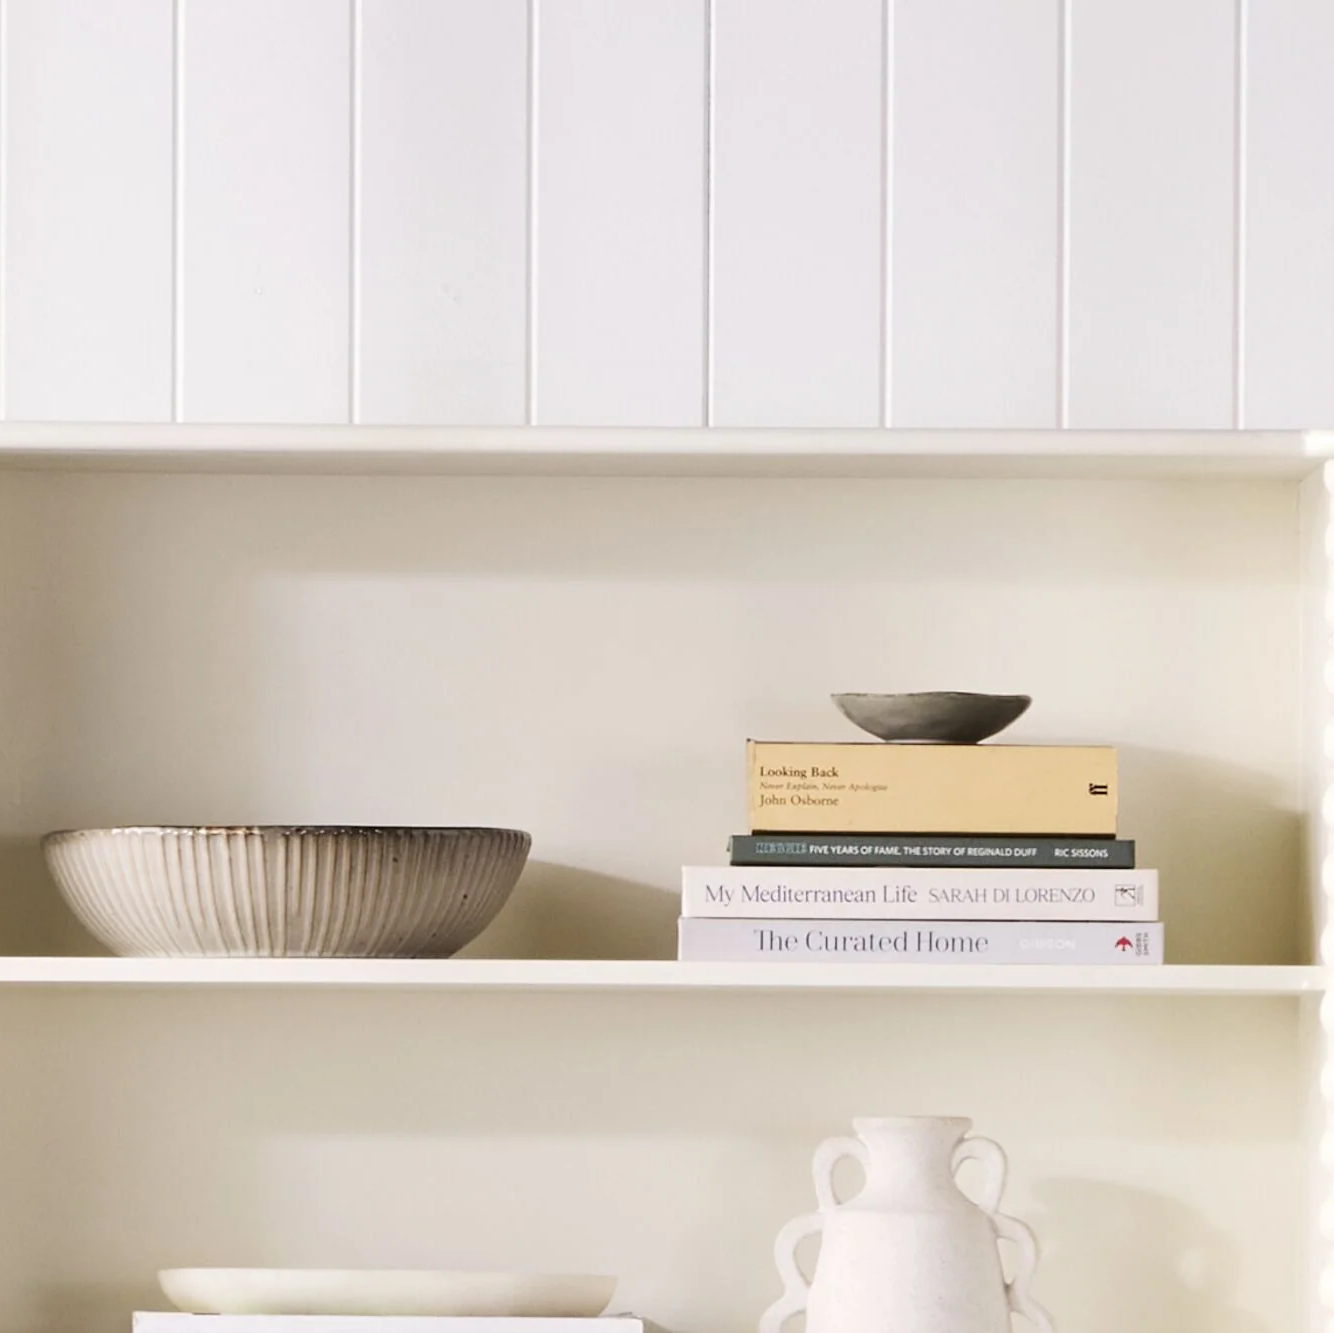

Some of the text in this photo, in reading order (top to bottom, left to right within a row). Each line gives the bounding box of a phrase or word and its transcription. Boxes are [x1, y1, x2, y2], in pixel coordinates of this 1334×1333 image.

[760, 766, 839, 779] Looking Back
[759, 794, 839, 807] John Osborne
[809, 845, 828, 854] FIVE
[830, 845, 859, 855] YEARS
[860, 846, 873, 855] OF
[903, 846, 921, 856] THE
[923, 847, 951, 856] STORY
[953, 847, 966, 856] OF
[967, 847, 1012, 857] REGINALD
[1013, 847, 1037, 857] DUFF
[1054, 848, 1109, 858] RIC SISSONS
[705, 885, 1096, 907] My Mediterranean Life SARAH DI LORENZO
[754, 929, 989, 953] The Curated Home
